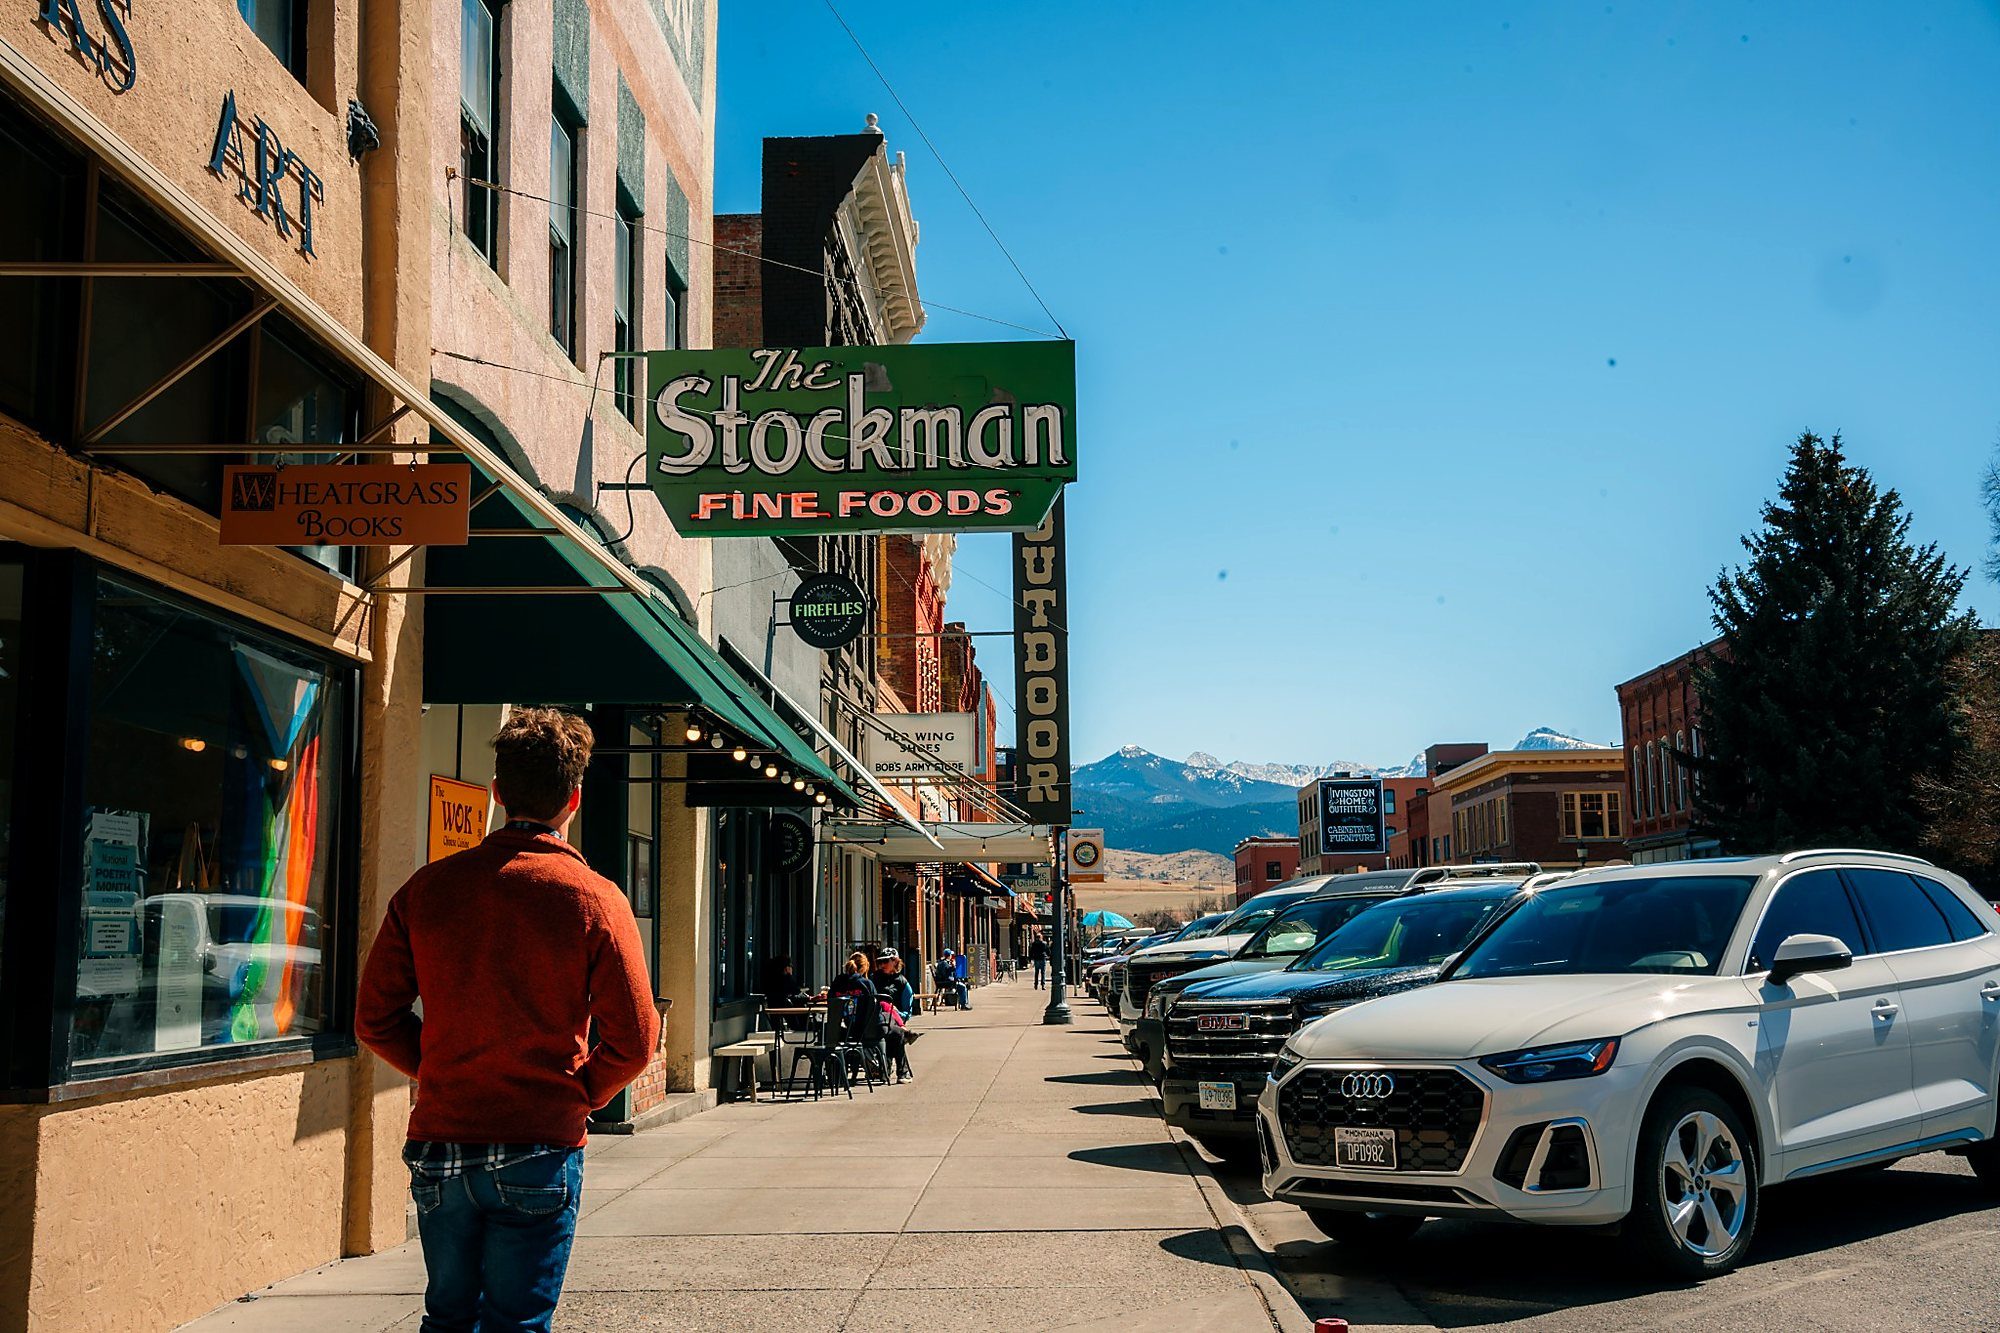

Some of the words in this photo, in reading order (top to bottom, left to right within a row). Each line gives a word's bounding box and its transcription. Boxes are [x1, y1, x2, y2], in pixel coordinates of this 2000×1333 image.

[209, 89, 324, 259] ART
[744, 348, 842, 391] The
[654, 372, 1069, 475] Stockman
[233, 473, 458, 509] WHEATGRASS
[696, 491, 821, 519] FINE
[838, 490, 1014, 518] FOODS
[795, 602, 863, 617] FIREFLIES
[915, 732, 954, 741] WING
[875, 762, 901, 771] BOB'S
[905, 763, 931, 771] ARMY
[1328, 787, 1375, 801] LIVINGSTON
[442, 801, 472, 834] WOK
[1328, 825, 1366, 833] CABINETRY
[1329, 834, 1375, 842] FURNITURE
[1200, 1015, 1242, 1028] GMC
[1350, 1130, 1379, 1138] MONTANA
[1347, 1143, 1385, 1162] DPD982
